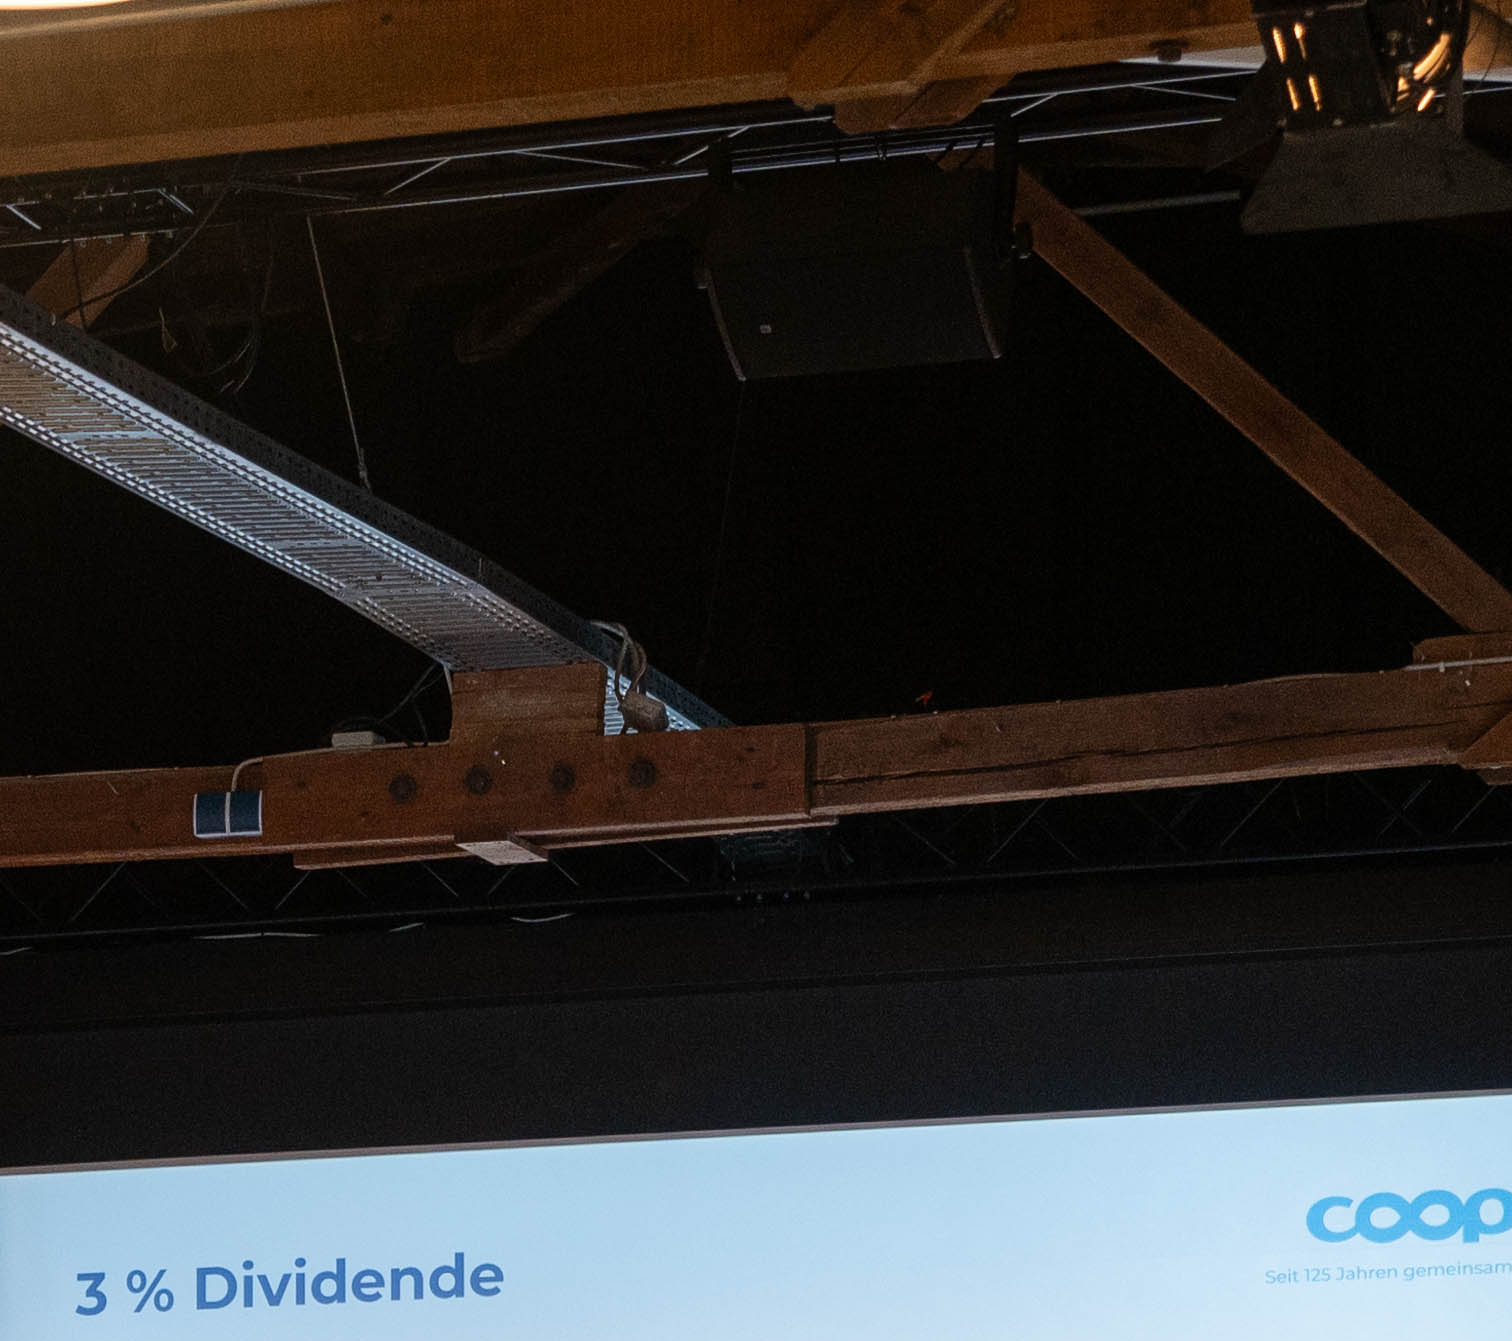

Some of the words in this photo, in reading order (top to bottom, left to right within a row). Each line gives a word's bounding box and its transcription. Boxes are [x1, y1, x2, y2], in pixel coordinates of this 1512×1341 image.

[75, 1271, 108, 1316] 3
[125, 1268, 175, 1314] %
[195, 1251, 504, 1310] Dividende
[1265, 1268, 1300, 1285] Seit
[1303, 1266, 1331, 1283] 125
[1336, 1263, 1398, 1281] Jahren
